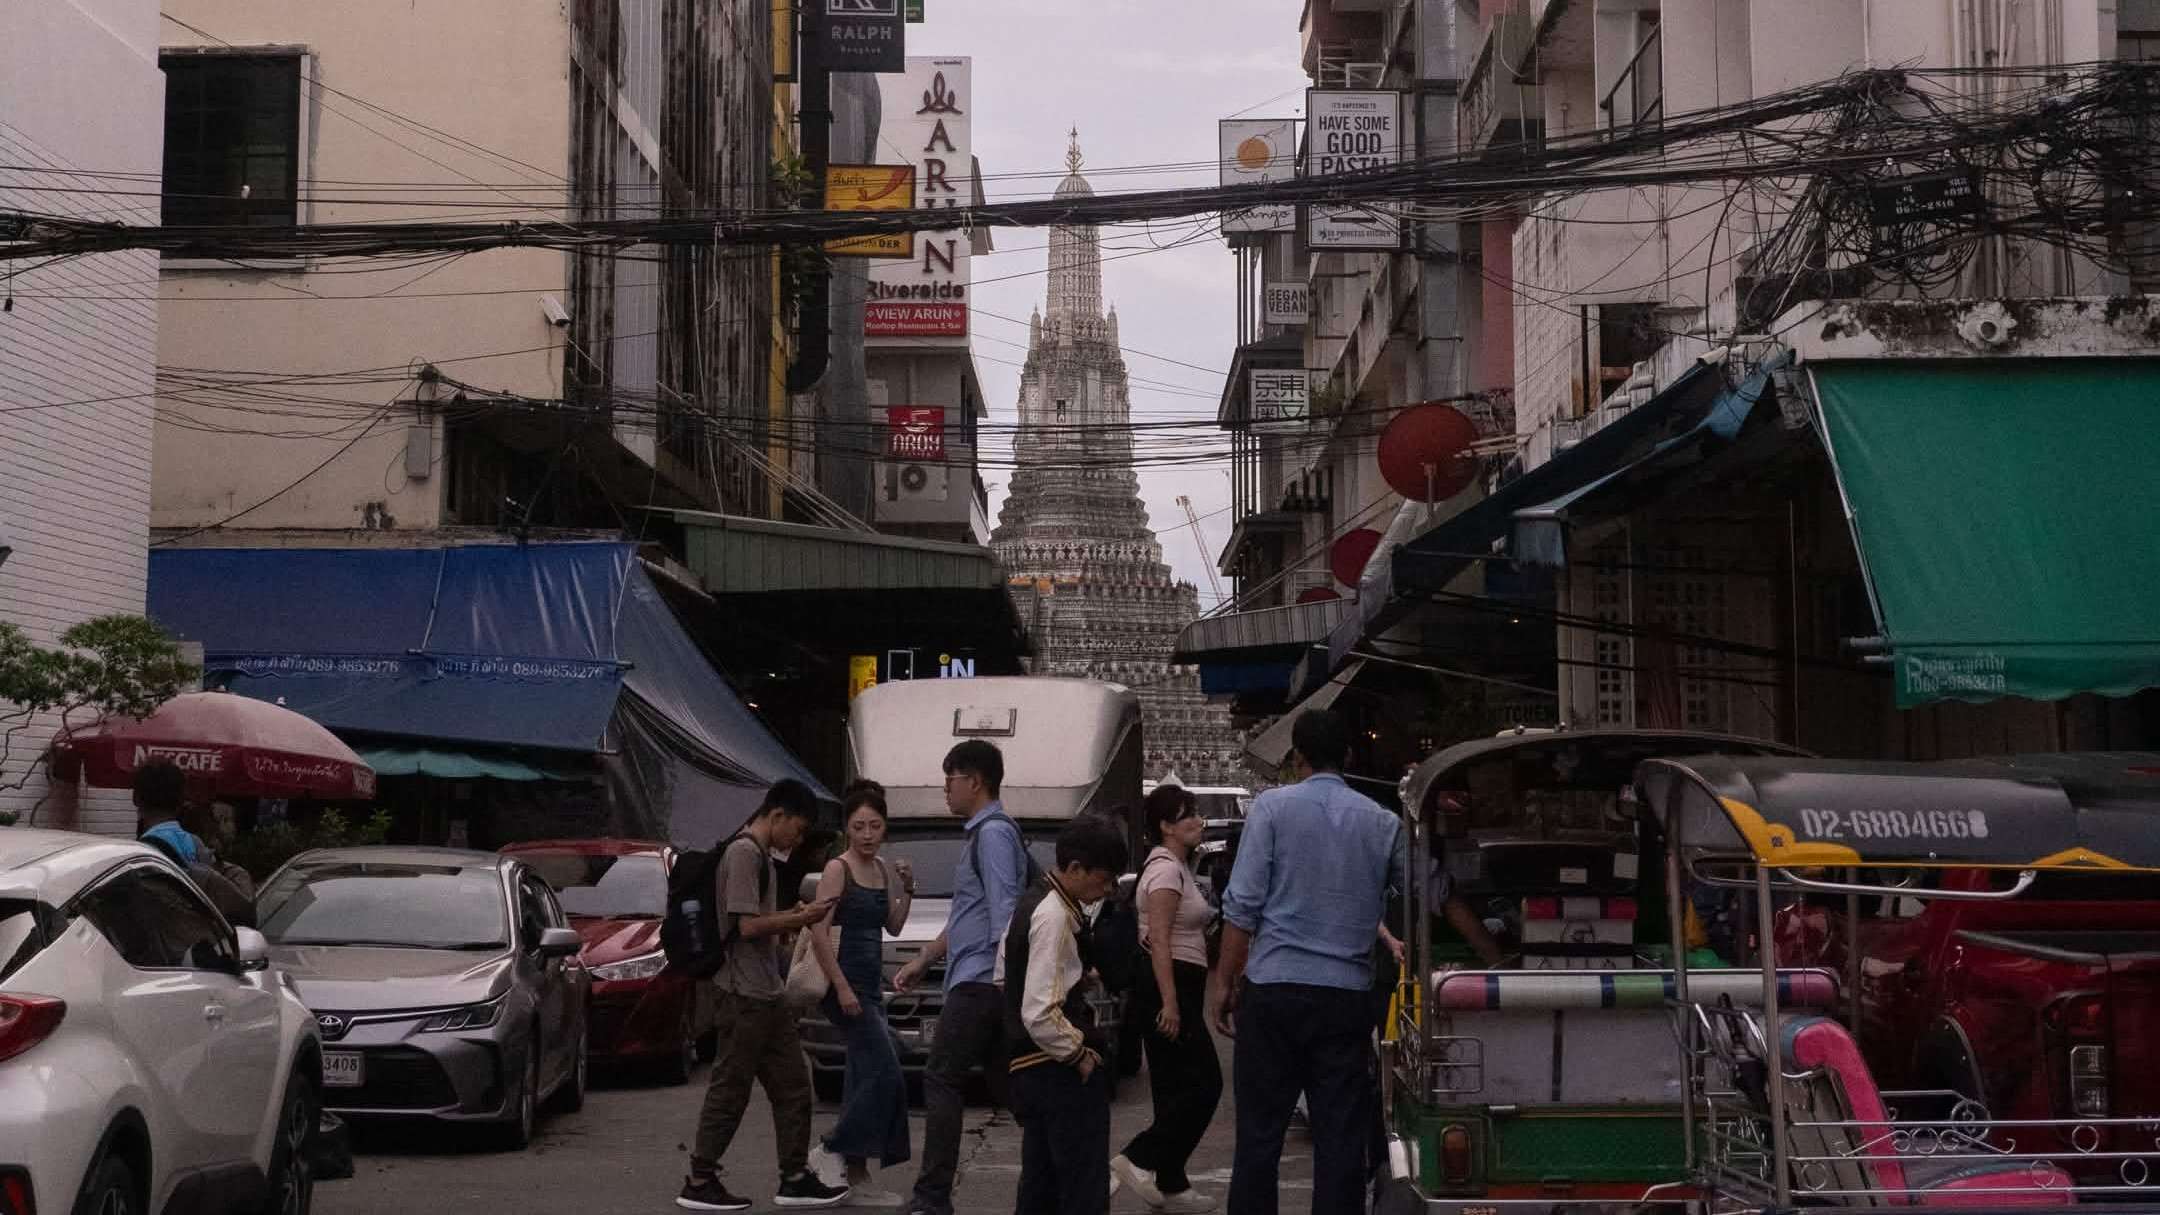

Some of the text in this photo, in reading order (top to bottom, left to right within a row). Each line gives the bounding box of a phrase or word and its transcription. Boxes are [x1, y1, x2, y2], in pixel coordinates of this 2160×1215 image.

[831, 26, 892, 40] RALPH
[1319, 116, 1390, 131] HAVE SOME
[1327, 132, 1381, 154] GOOD
[875, 308, 952, 320] VIEW ARUN
[1268, 301, 1307, 313] VEGAN
[133, 745, 224, 771] NCAFÉ
[324, 1056, 357, 1071] 3408
